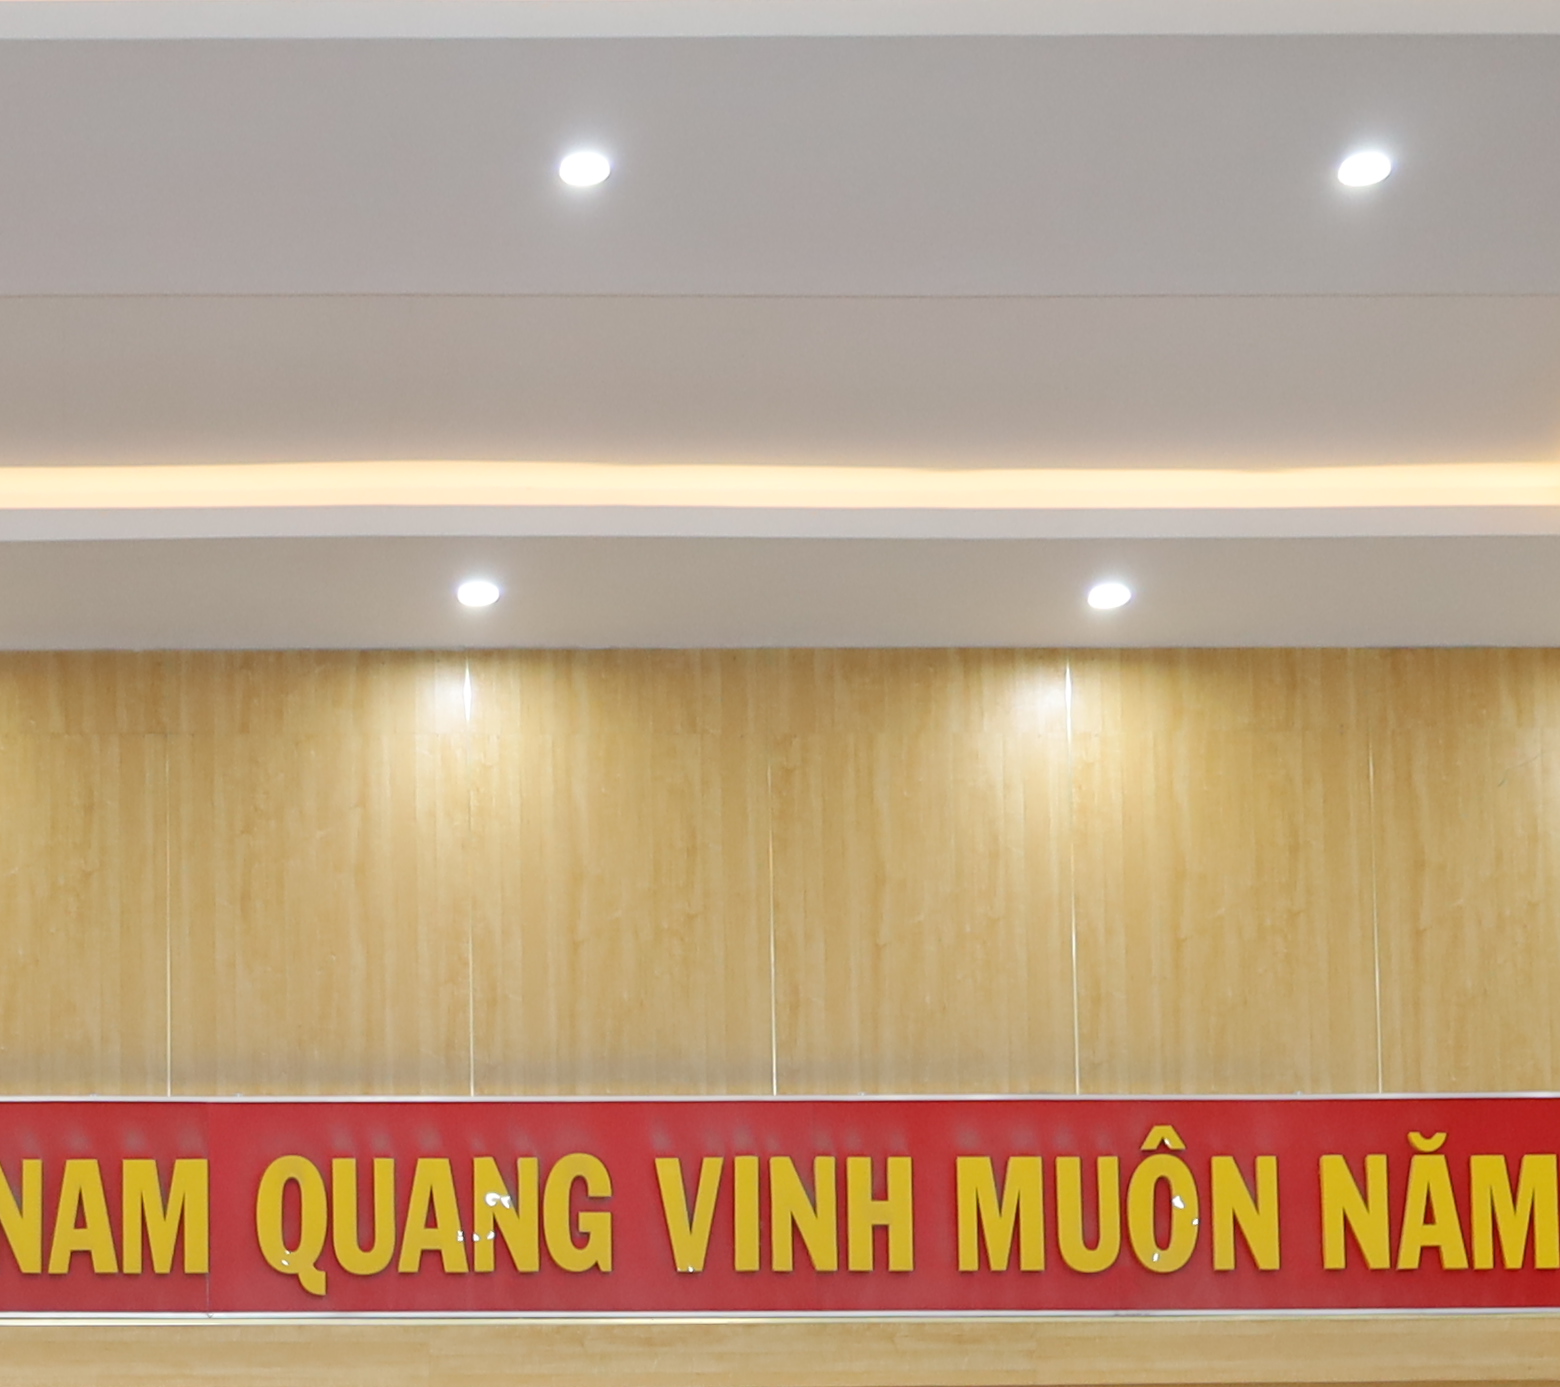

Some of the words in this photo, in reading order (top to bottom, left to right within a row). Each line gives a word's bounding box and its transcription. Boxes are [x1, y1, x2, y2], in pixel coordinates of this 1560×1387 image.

[257, 1153, 612, 1290] QUANG
[655, 1155, 913, 1272] VINH
[956, 1125, 1279, 1272] MUÔN
[1320, 1132, 1560, 1269] NĂM
